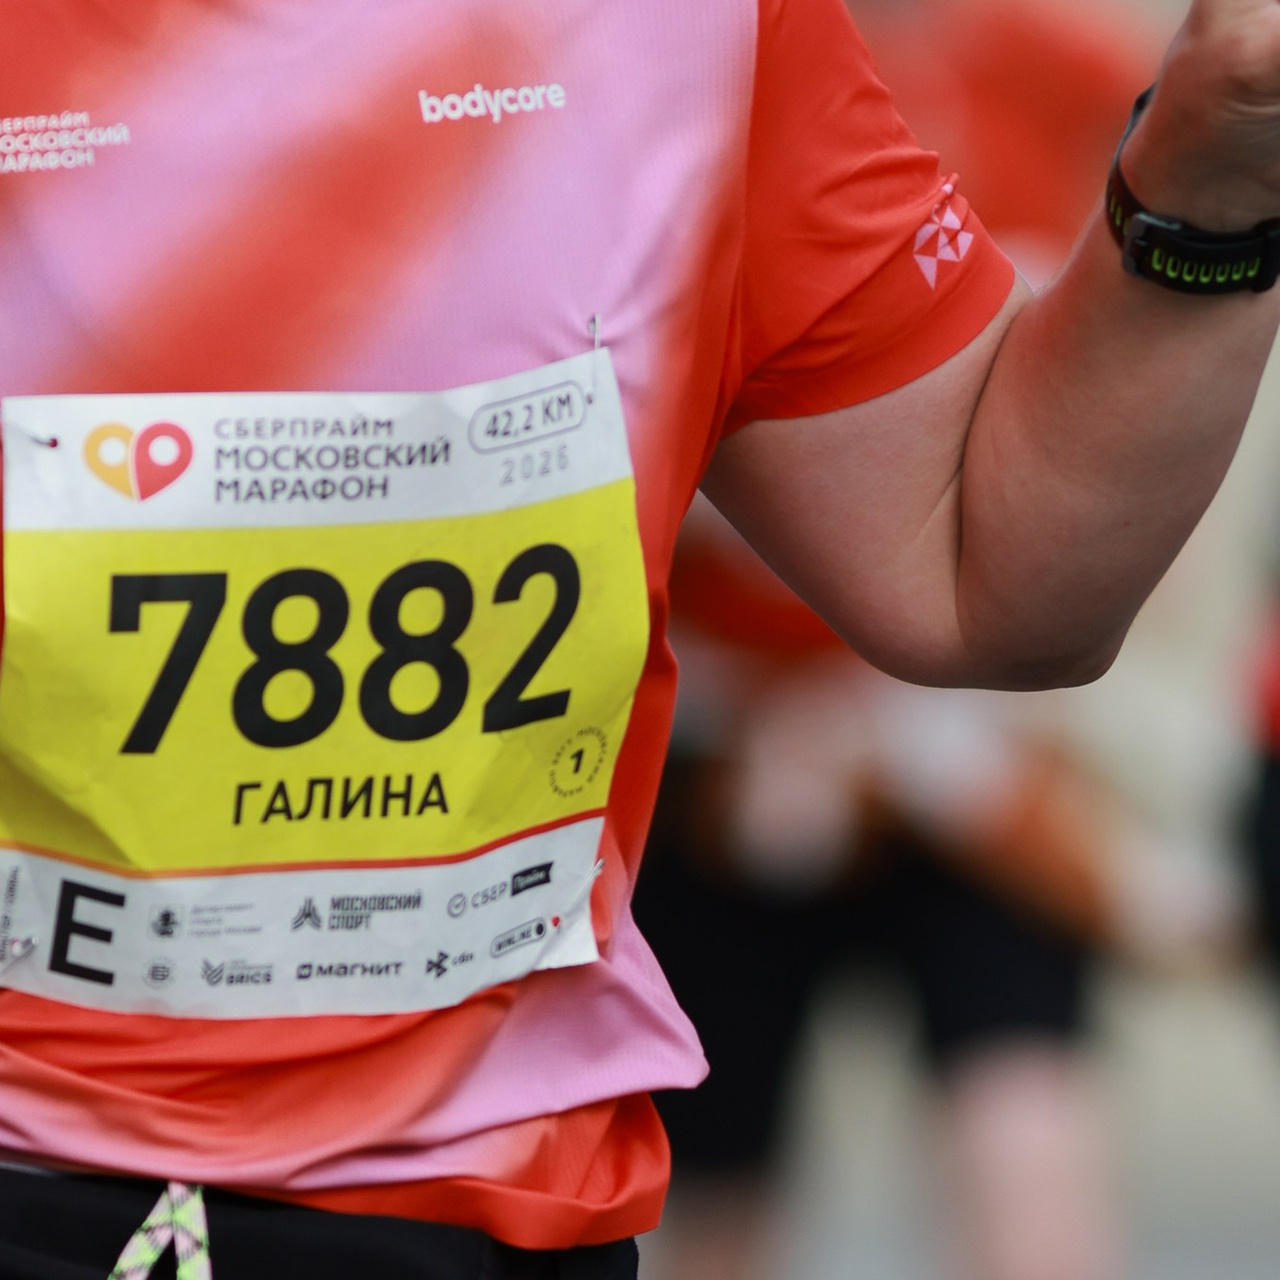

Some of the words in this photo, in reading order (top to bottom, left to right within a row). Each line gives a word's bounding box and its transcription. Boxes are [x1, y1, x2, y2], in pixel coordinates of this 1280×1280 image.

[418, 83, 565, 124] bodycore
[213, 413, 395, 440] СБЕРПРАЙМ
[484, 403, 534, 438] 42,2
[213, 436, 452, 472] МОСКОВСКИЙ
[213, 476, 389, 504] МАРАФОН
[108, 543, 581, 755] 7882
[570, 747, 585, 775] 1
[232, 772, 450, 826] ГАЛИНА
[330, 888, 423, 912] МОСКОВСКИЙ
[471, 881, 507, 908] СБЕР
[328, 914, 372, 931] СПОРТ
